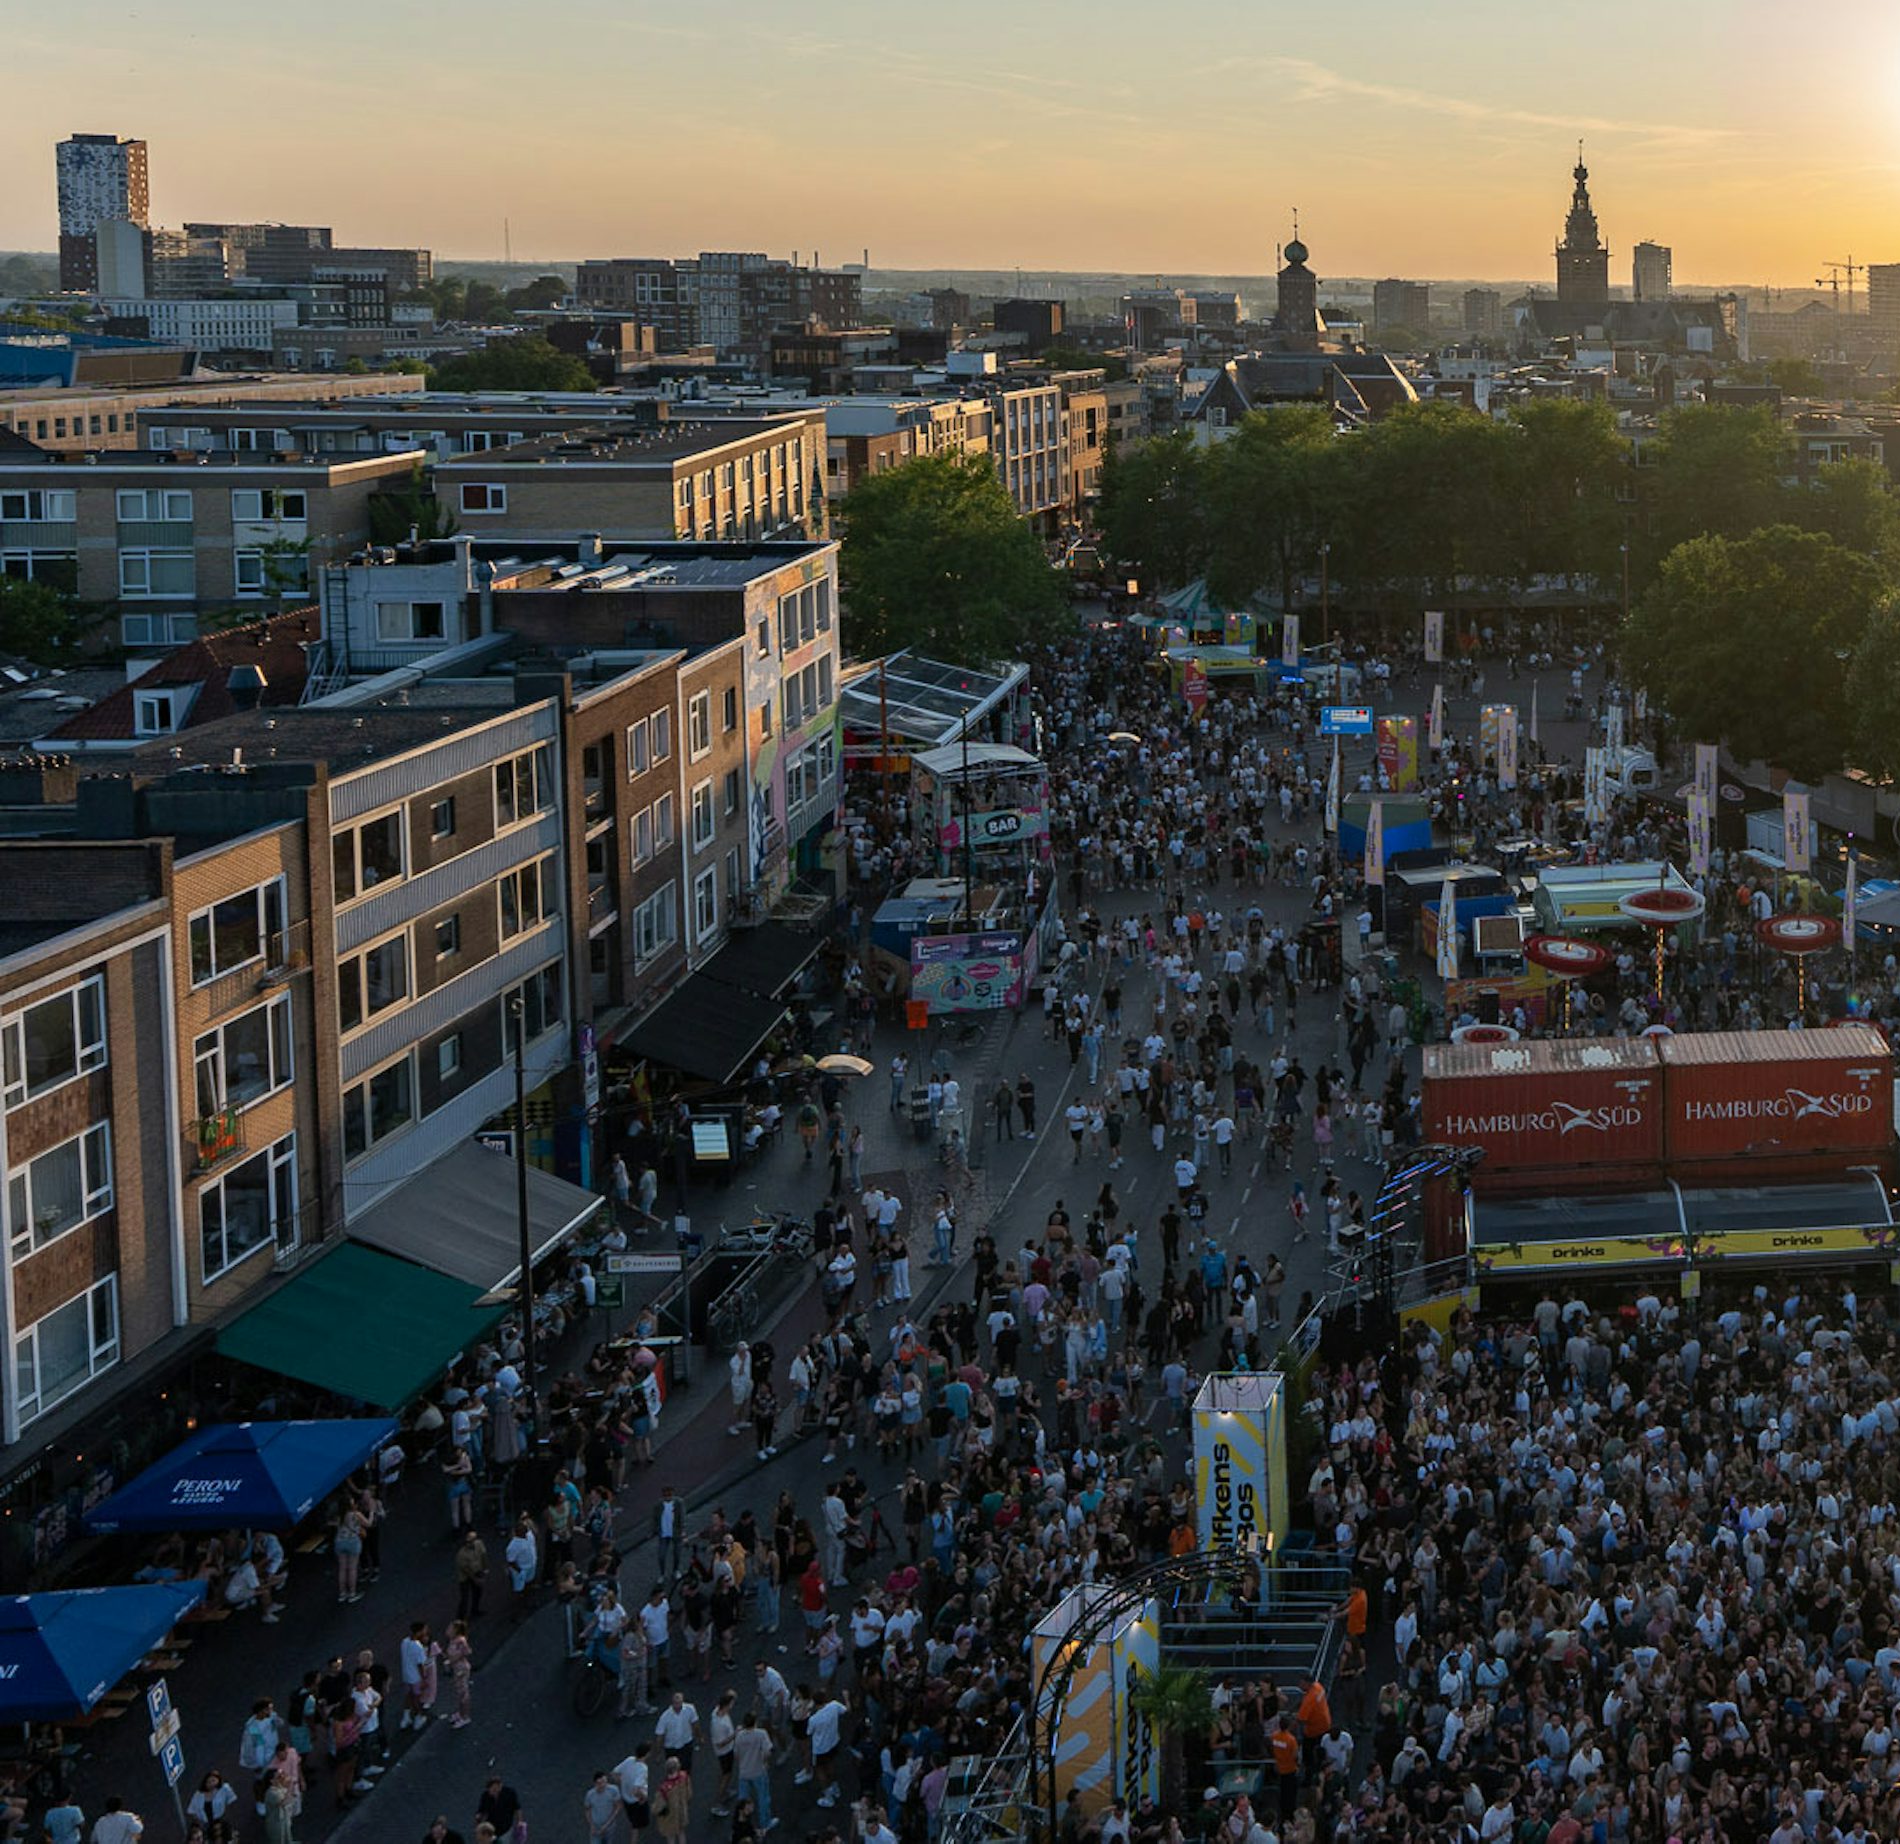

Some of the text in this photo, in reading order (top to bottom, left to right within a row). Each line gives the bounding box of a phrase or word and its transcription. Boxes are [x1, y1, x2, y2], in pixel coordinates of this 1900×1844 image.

[988, 817, 1017, 834] BAR
[1686, 1093, 1872, 1121] HAMBURG SÜD
[1446, 1103, 1641, 1135] HAMBURG SÜD
[1773, 1234, 1824, 1246] Drinks
[1552, 1246, 1605, 1258] Drinks
[172, 1478, 243, 1493] PERONI
